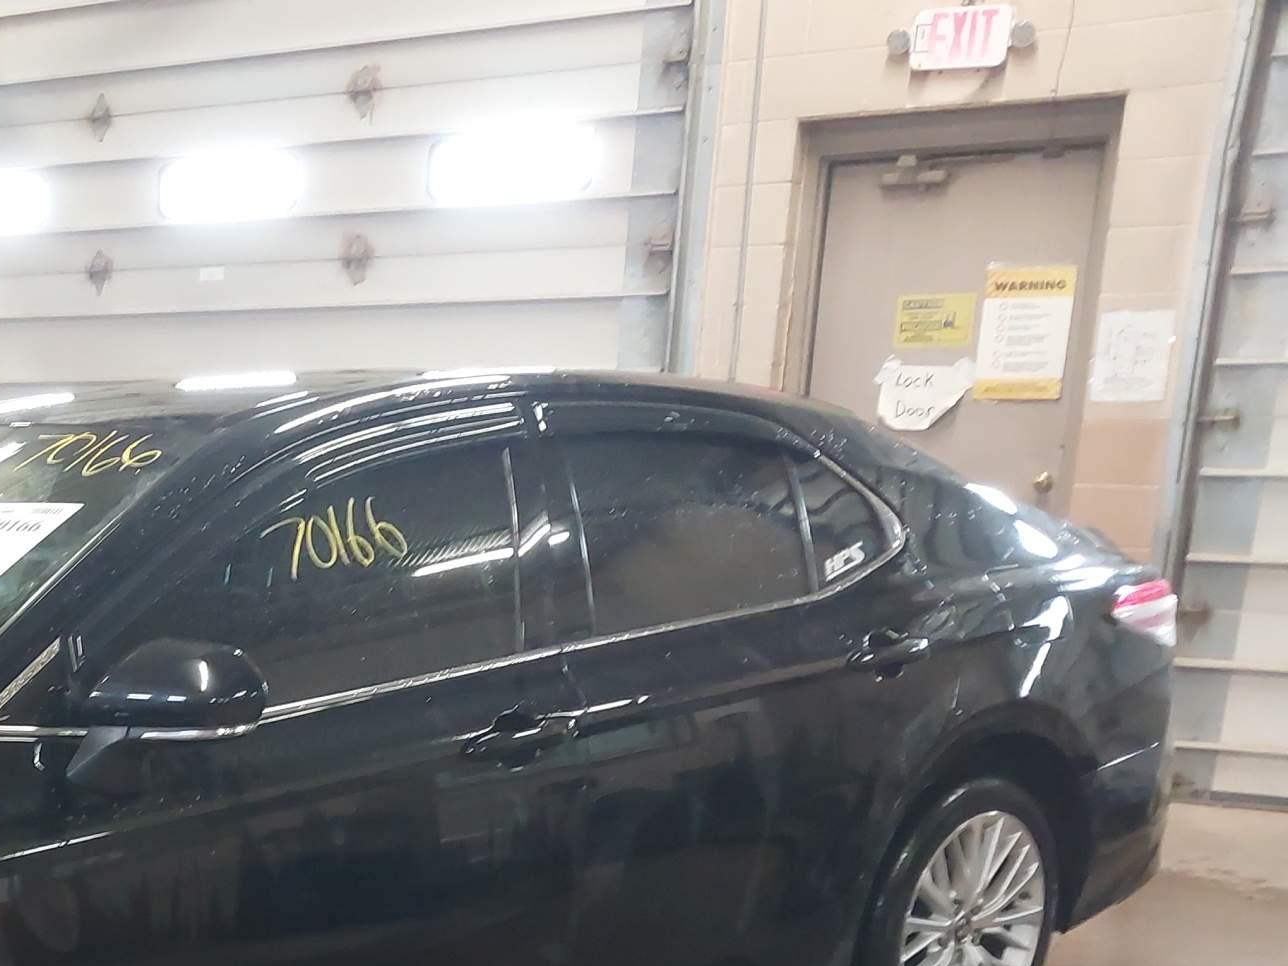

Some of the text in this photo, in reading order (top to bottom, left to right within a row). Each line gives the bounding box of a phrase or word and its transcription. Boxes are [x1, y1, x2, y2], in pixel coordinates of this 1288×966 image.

[926, 9, 1000, 60] EXIT
[993, 279, 1068, 292] WARNING
[895, 372, 937, 389] Lock
[895, 400, 935, 419] Door
[13, 430, 162, 477] 70166
[260, 496, 408, 582] 70166
